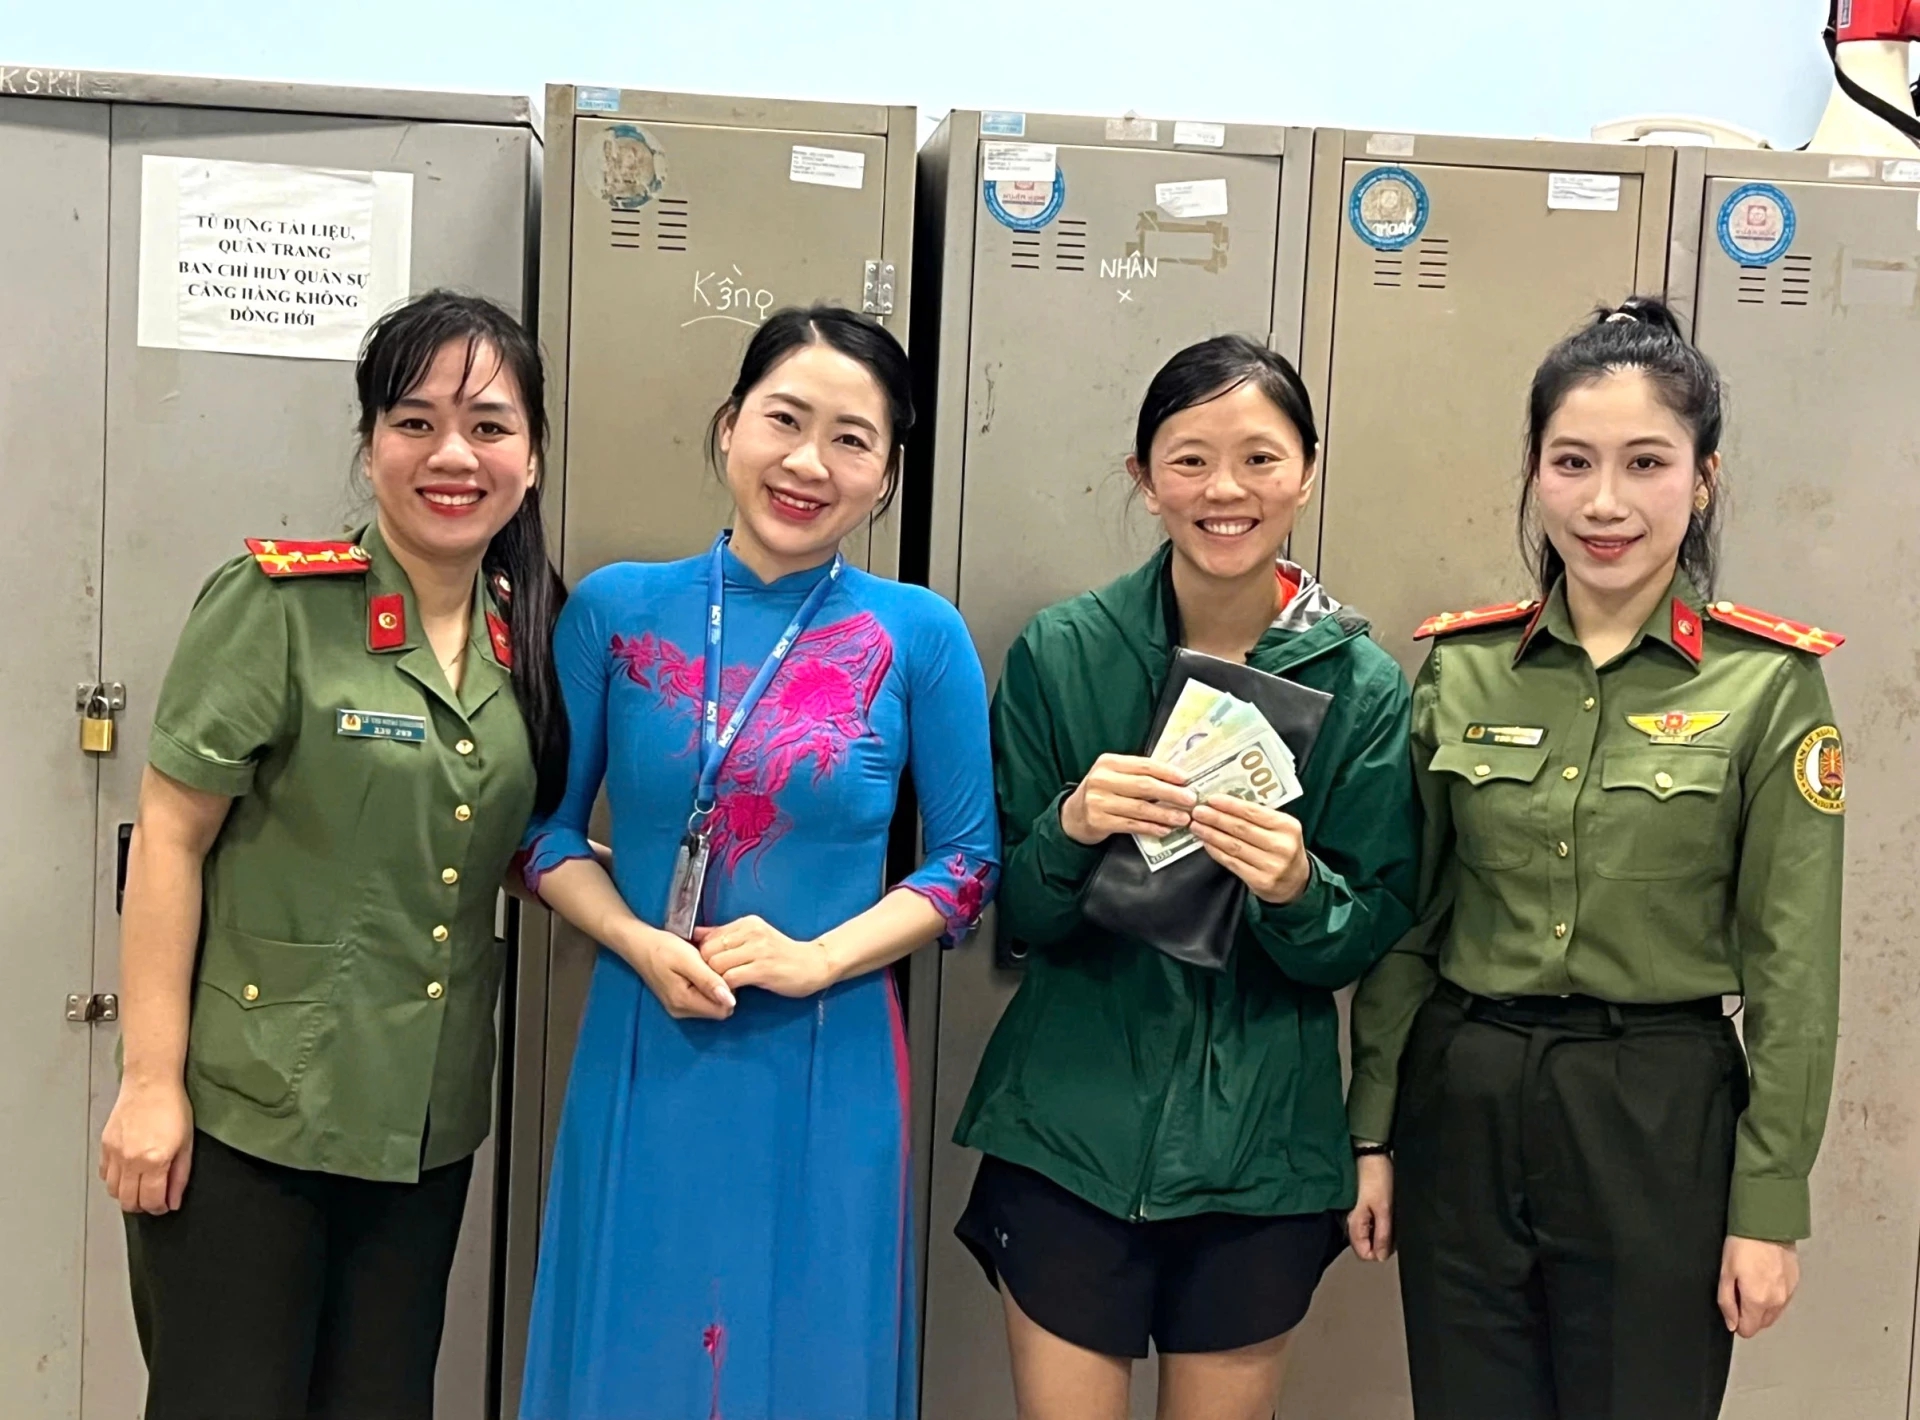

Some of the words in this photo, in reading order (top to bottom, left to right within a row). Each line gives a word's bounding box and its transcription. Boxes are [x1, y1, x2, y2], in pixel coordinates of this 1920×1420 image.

[271, 242, 331, 259] TRANG
[179, 261, 213, 274] BAN
[254, 266, 290, 281] HUY
[294, 268, 342, 285] QUÂN
[1100, 250, 1158, 279] NHÂN
[296, 290, 358, 308] KHÔNG
[1240, 750, 1279, 800] 100
